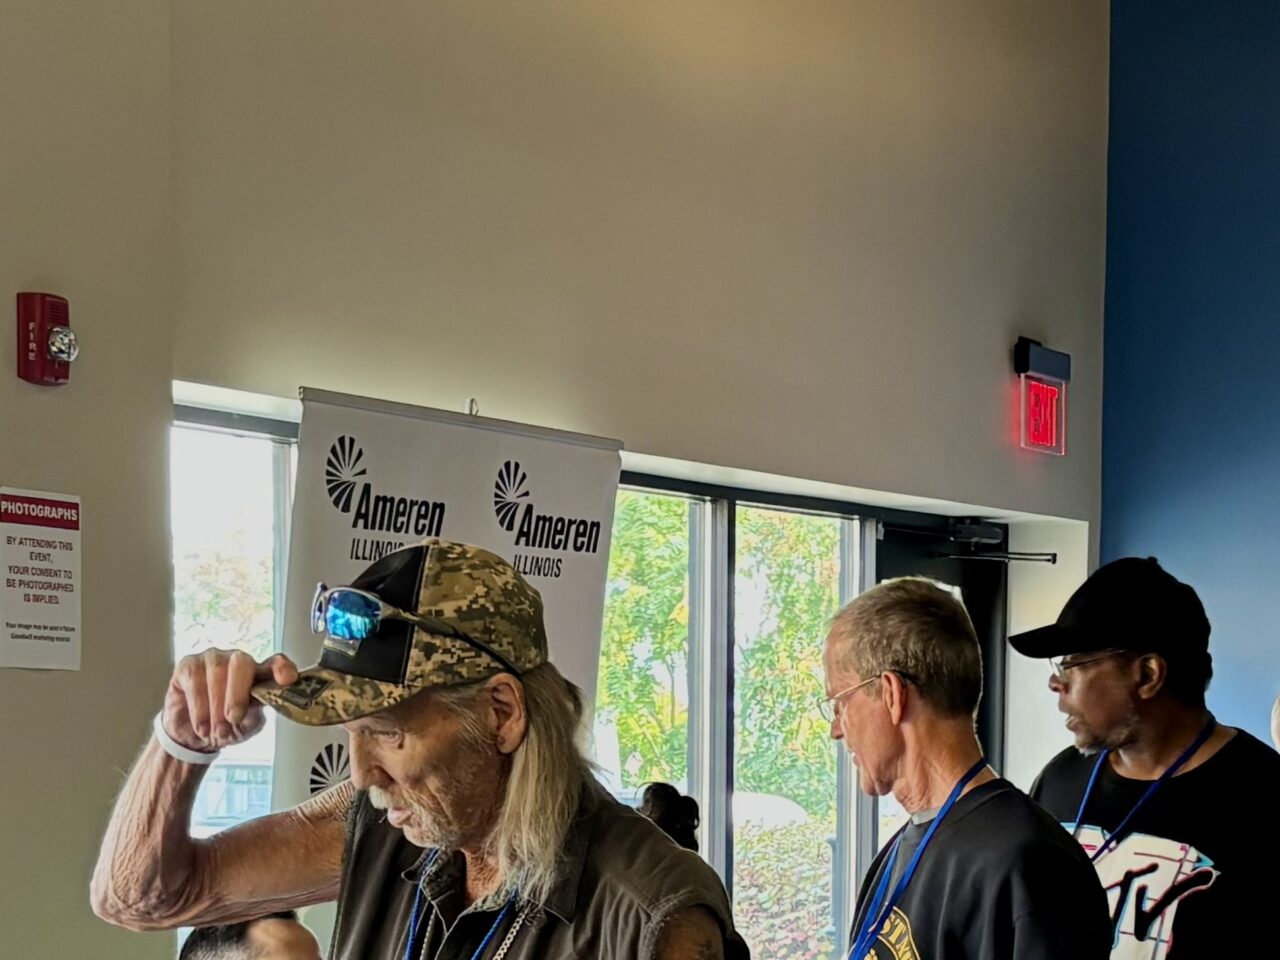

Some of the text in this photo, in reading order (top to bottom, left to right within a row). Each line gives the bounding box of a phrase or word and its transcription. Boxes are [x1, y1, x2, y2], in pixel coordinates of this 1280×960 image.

[28, 322, 37, 361] FIRE
[1030, 380, 1059, 447] EXIT
[0, 500, 78, 521] PHOTOGRAPHS
[351, 482, 446, 538] Ameren
[514, 503, 601, 554] Ameren
[18, 537, 58, 551] ATTENDING
[513, 553, 563, 578] ILLINOIS
